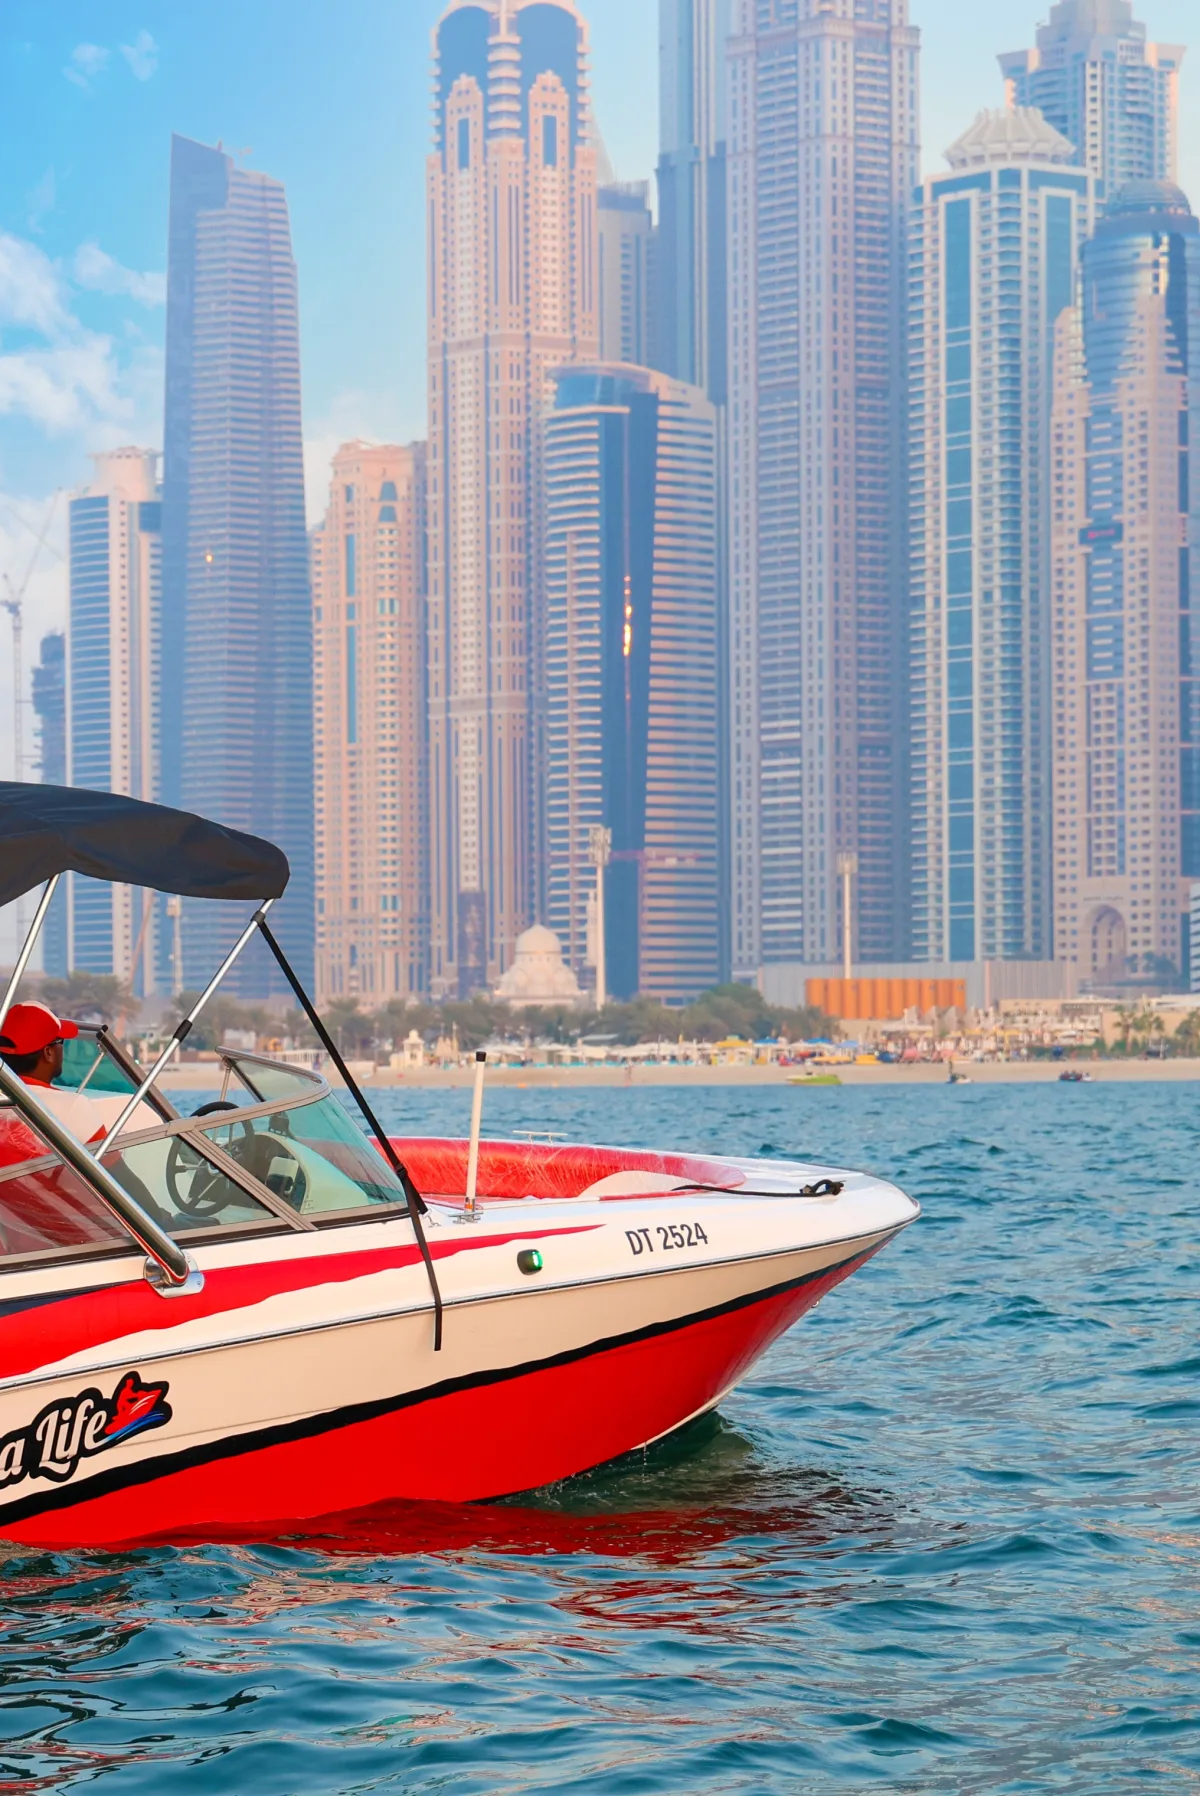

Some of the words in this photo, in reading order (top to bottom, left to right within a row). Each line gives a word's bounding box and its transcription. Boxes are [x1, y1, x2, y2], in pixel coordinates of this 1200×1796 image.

[624, 1227, 654, 1256] DT
[656, 1222, 709, 1251] 2524
[36, 1399, 110, 1475] Life
